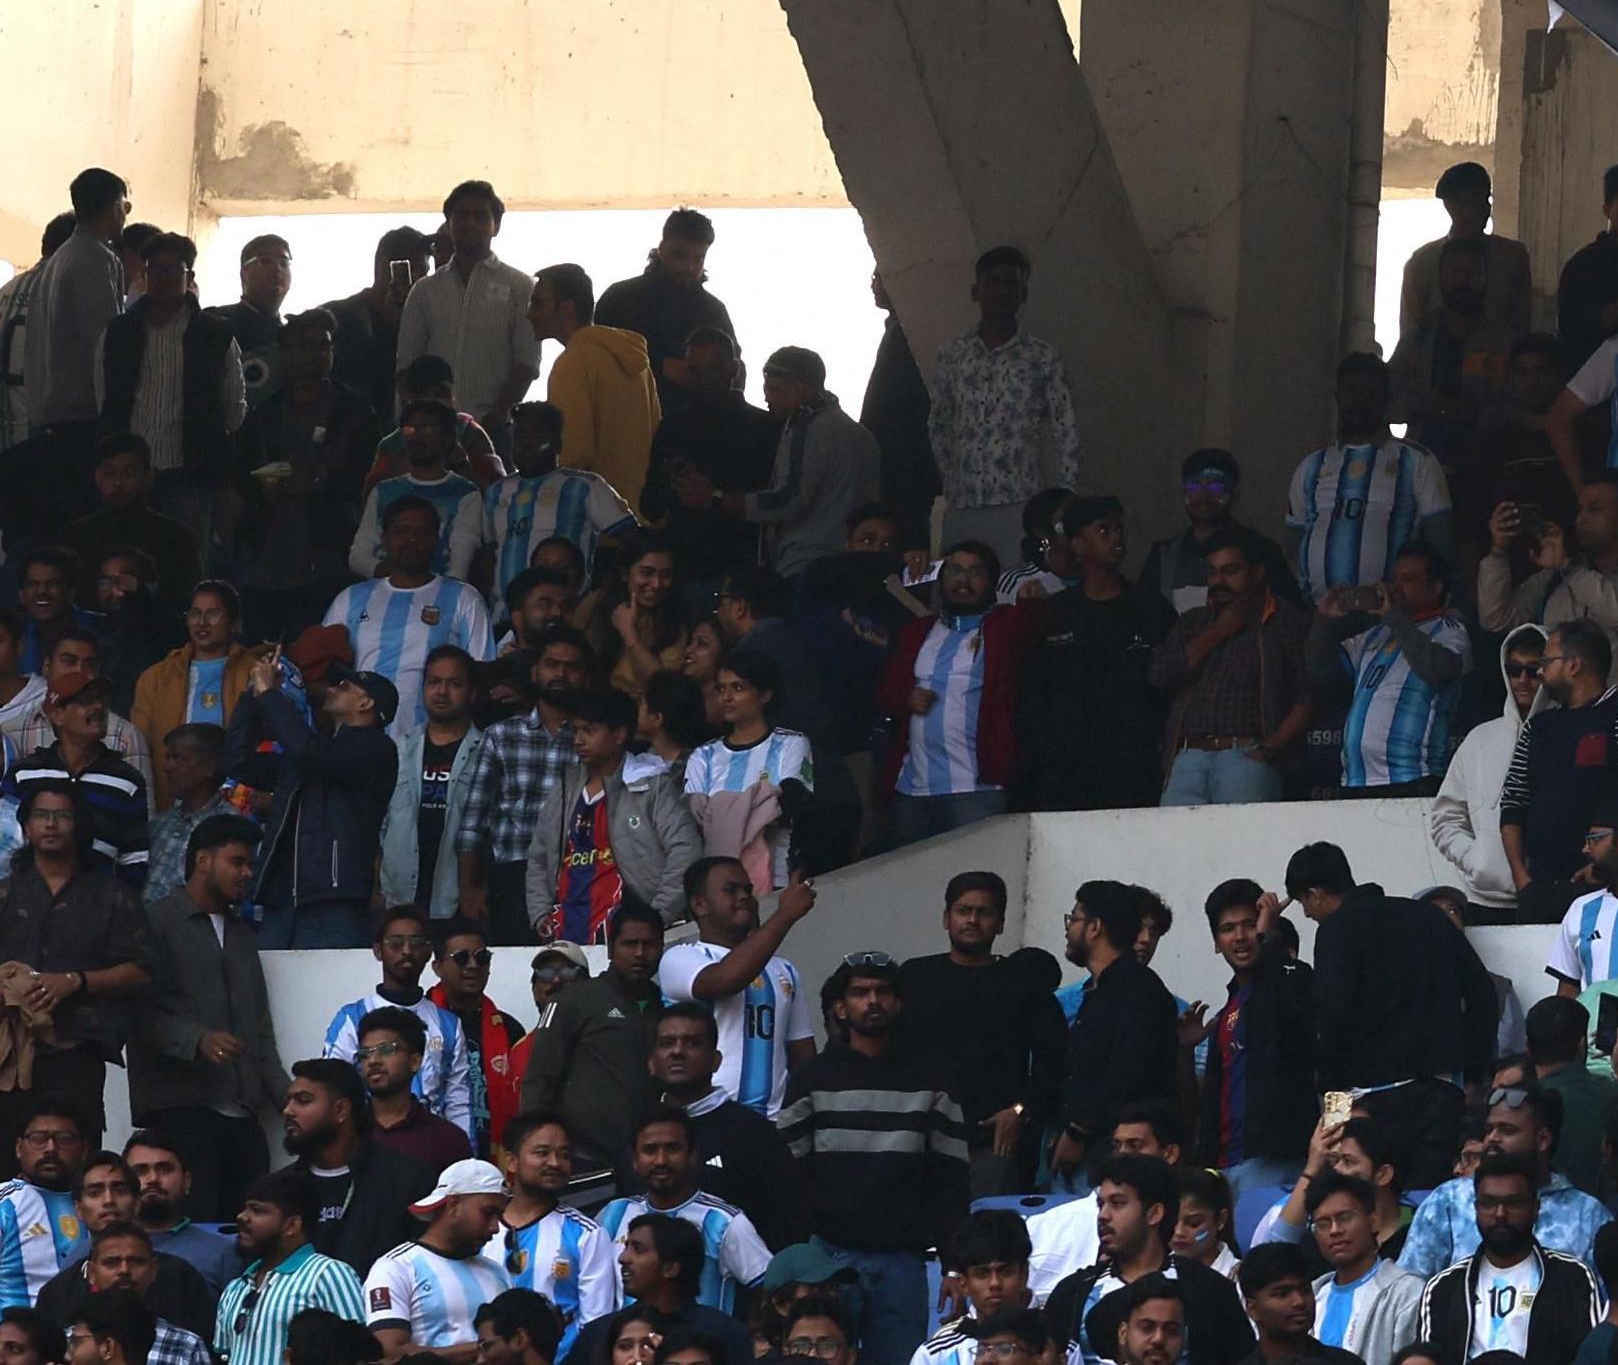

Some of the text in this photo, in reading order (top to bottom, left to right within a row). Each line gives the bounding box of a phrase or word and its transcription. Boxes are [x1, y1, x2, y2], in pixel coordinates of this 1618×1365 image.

[1334, 497, 1366, 519] 10
[1363, 663, 1386, 689] 10
[745, 1003, 775, 1041] 10
[1488, 1285, 1517, 1319] 10
